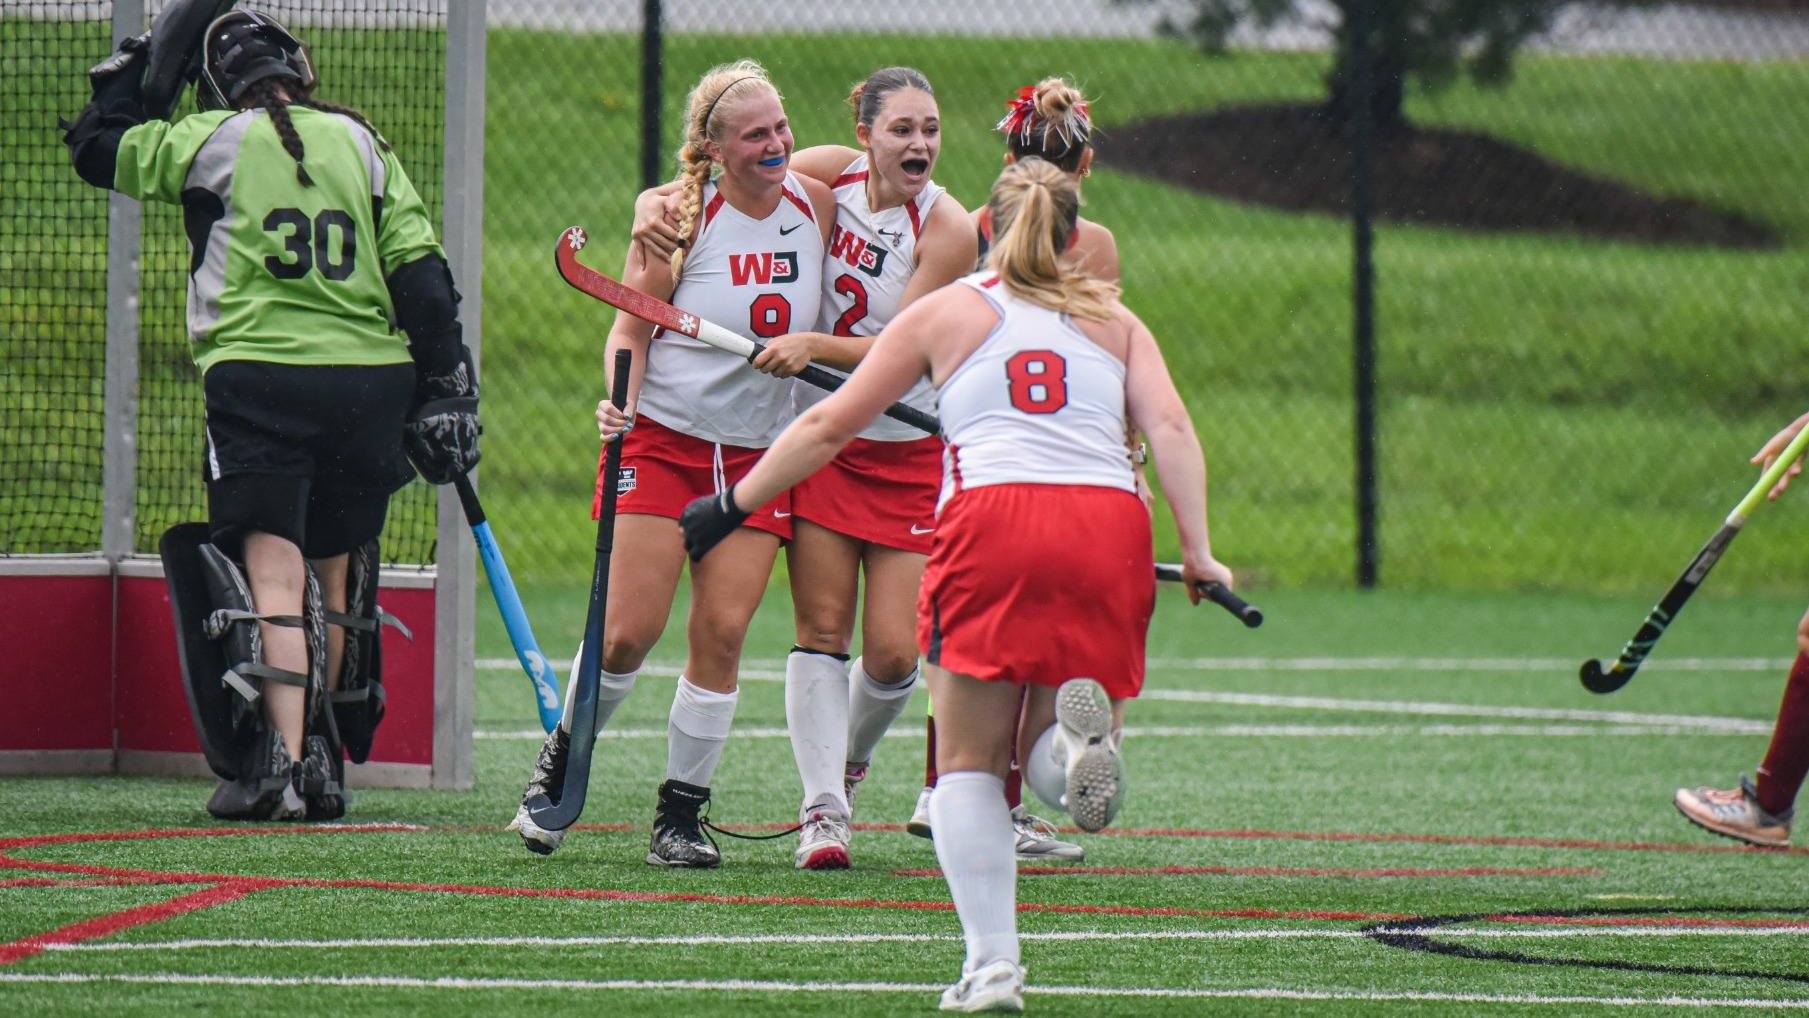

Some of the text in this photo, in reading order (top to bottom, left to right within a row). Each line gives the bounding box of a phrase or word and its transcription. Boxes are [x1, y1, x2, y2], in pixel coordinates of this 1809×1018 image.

[262, 207, 356, 281] 30
[728, 251, 799, 287] W&J
[829, 223, 888, 278] W&J
[749, 292, 791, 338] 9
[832, 272, 868, 337] 2
[1004, 348, 1068, 414] 8
